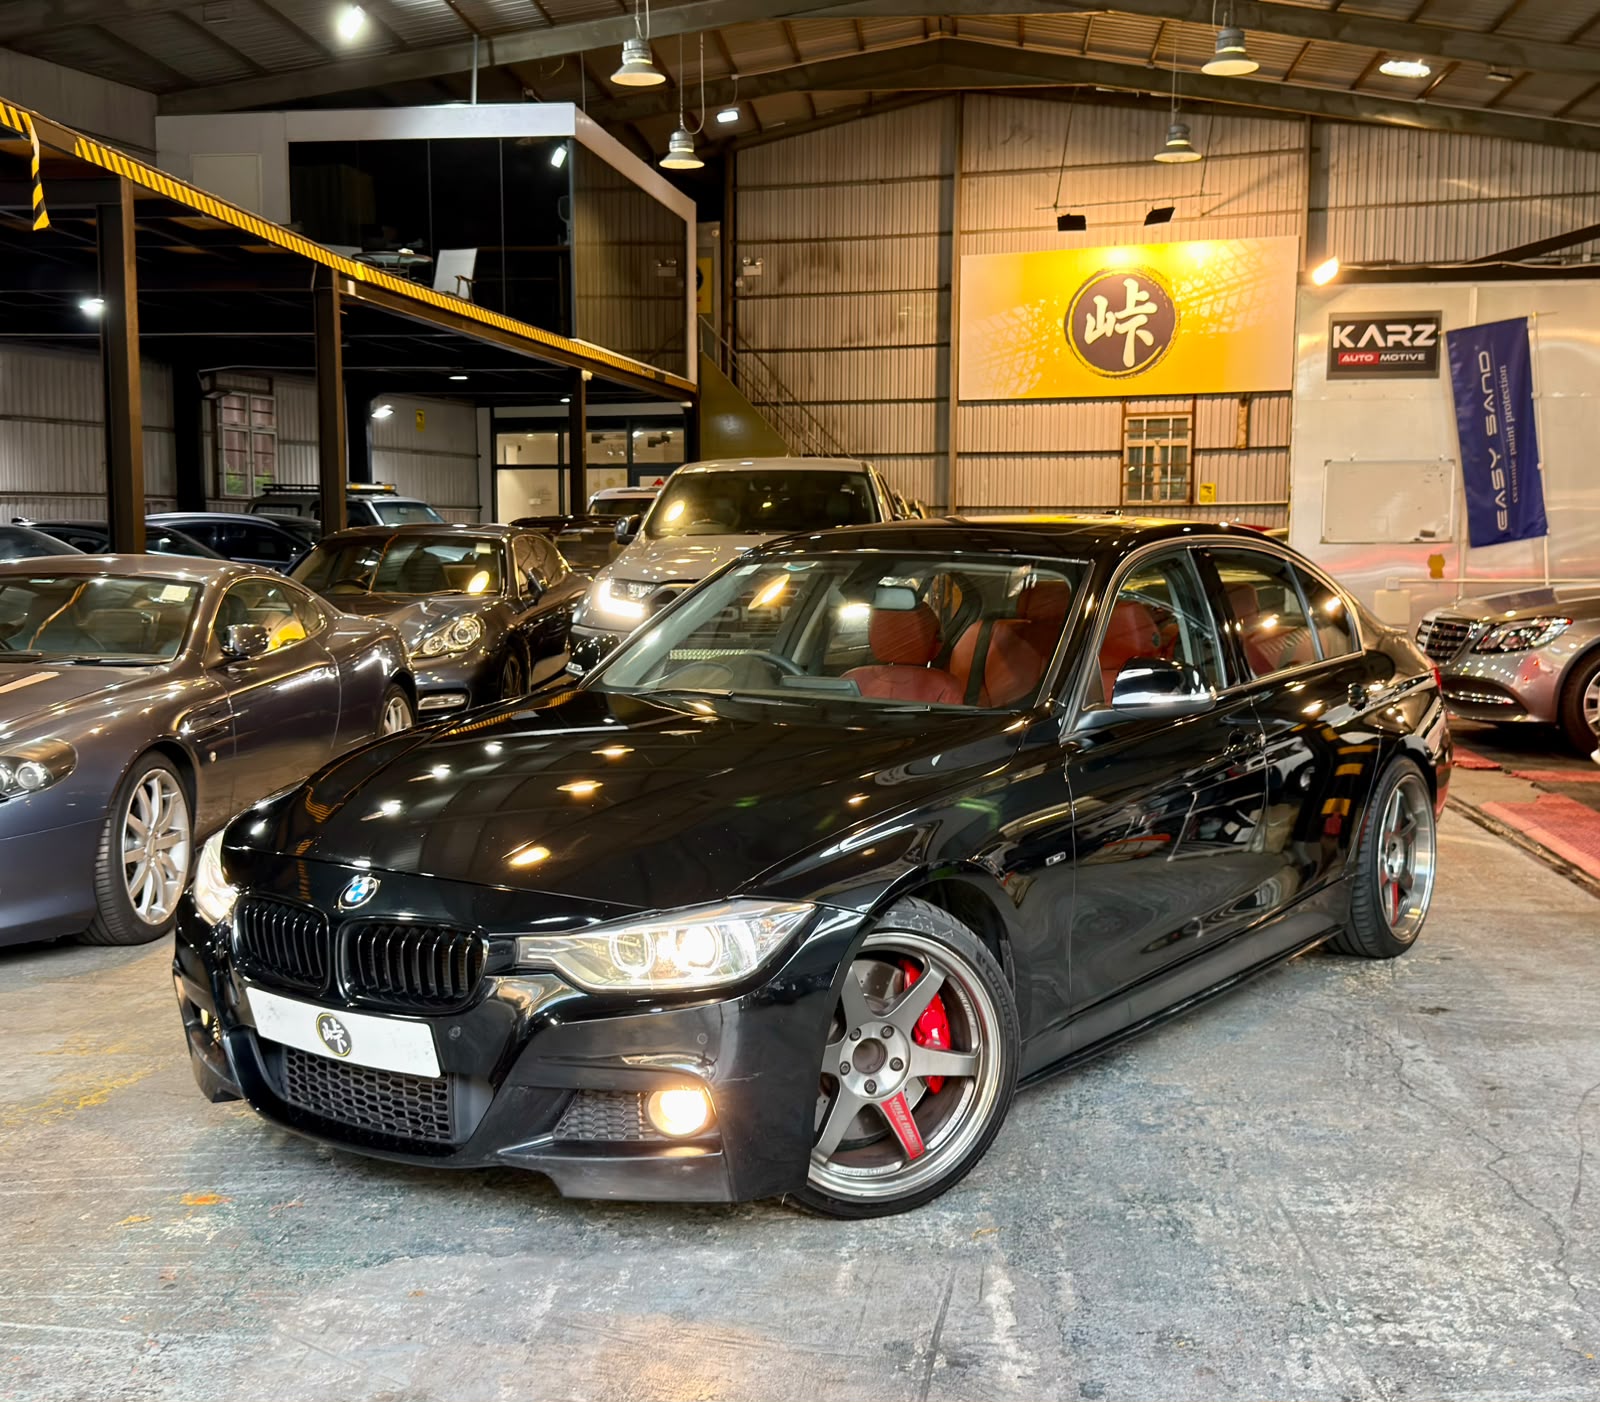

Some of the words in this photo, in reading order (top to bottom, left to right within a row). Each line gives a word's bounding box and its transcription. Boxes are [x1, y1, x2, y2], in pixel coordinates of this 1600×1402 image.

[1084, 278, 1158, 368] 峠
[1332, 323, 1437, 349] KARZ
[1341, 354, 1374, 363] AUTO
[1379, 353, 1426, 362] MOTIVE
[1478, 350, 1498, 437] SAND
[1500, 364, 1515, 424] protection
[1507, 425, 1517, 456] paint
[1488, 447, 1509, 531] EASY
[1509, 457, 1519, 503] ceramic
[322, 1017, 348, 1054] 峠
